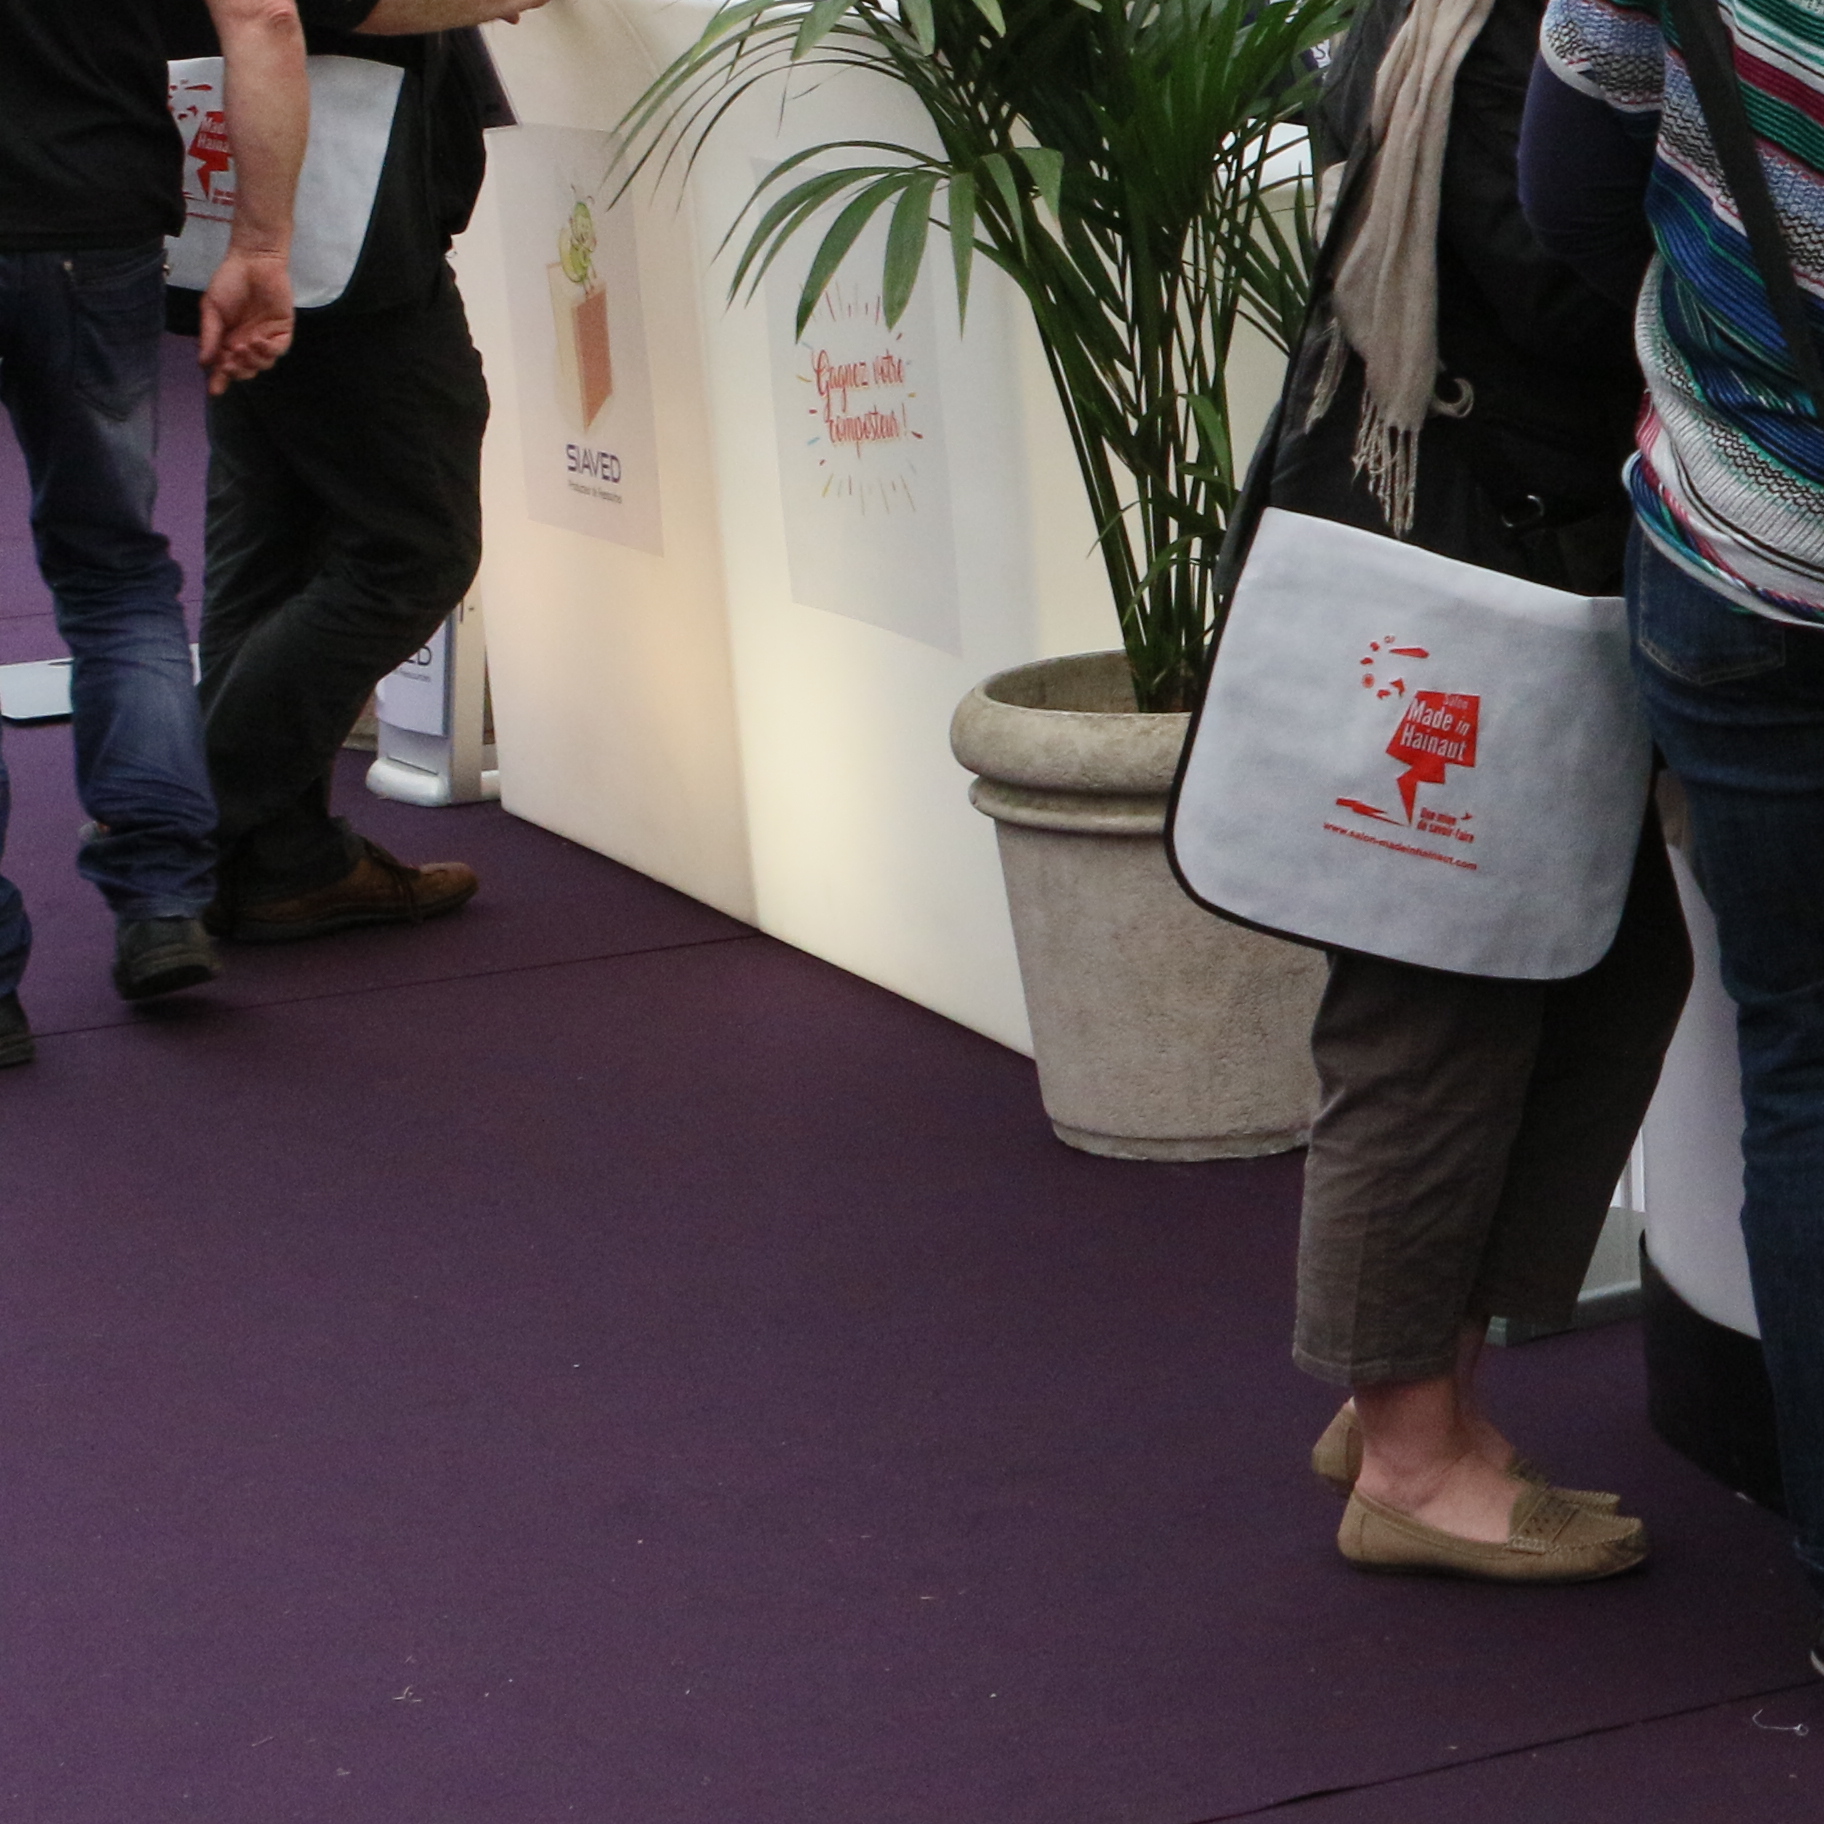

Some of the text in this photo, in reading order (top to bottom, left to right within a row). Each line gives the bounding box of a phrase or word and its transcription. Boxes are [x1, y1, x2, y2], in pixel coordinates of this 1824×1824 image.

[566, 443, 622, 484] SIAVED
[1408, 698, 1471, 736] Made in
[1400, 722, 1467, 761] Hainaut
